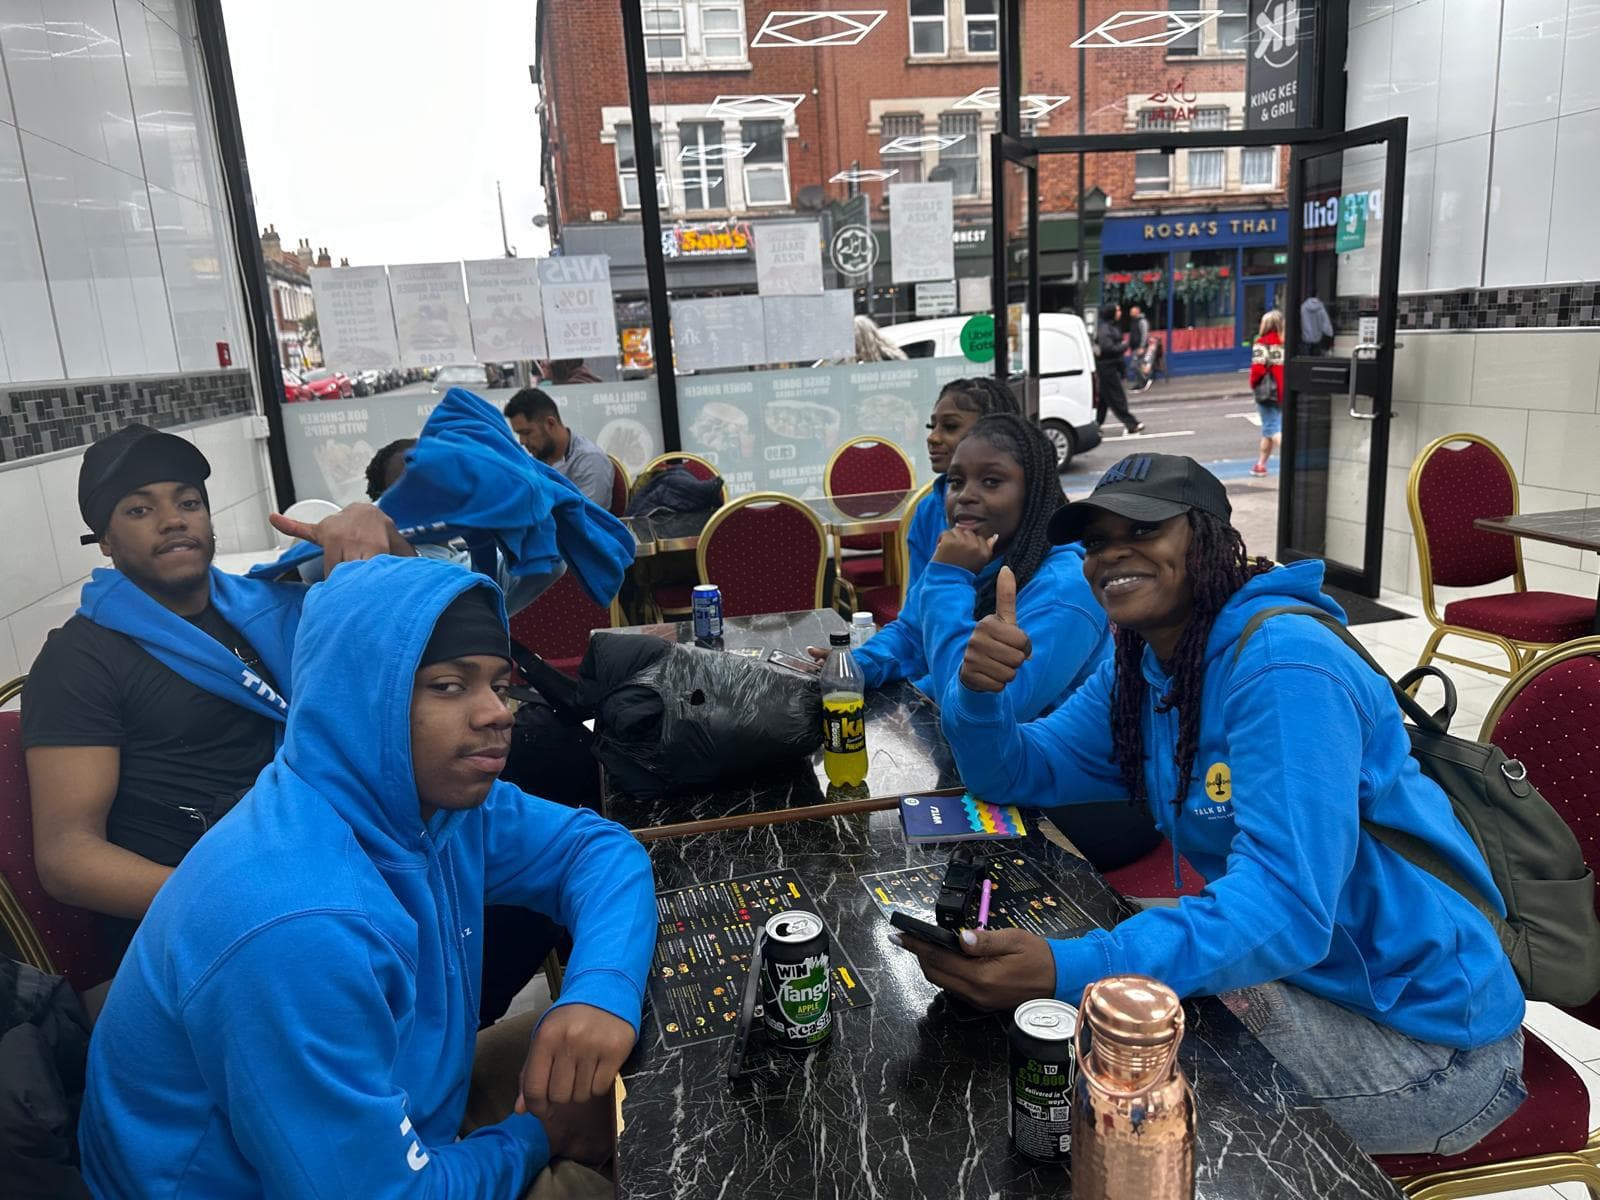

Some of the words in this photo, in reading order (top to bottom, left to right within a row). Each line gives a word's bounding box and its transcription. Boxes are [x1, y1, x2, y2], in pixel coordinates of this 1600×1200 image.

[1250, 87, 1276, 108] KING
[1260, 108, 1269, 122] &
[1144, 219, 1218, 239] ROSA'S
[1230, 217, 1277, 233] THAI
[967, 329, 993, 340] Uber
[969, 340, 993, 352] Eats
[1194, 806, 1214, 816] TALK
[777, 964, 808, 978] WIN
[781, 979, 830, 1002] Tango
[798, 1002, 819, 1013] APPLE
[1024, 1087, 1054, 1098] delivered
